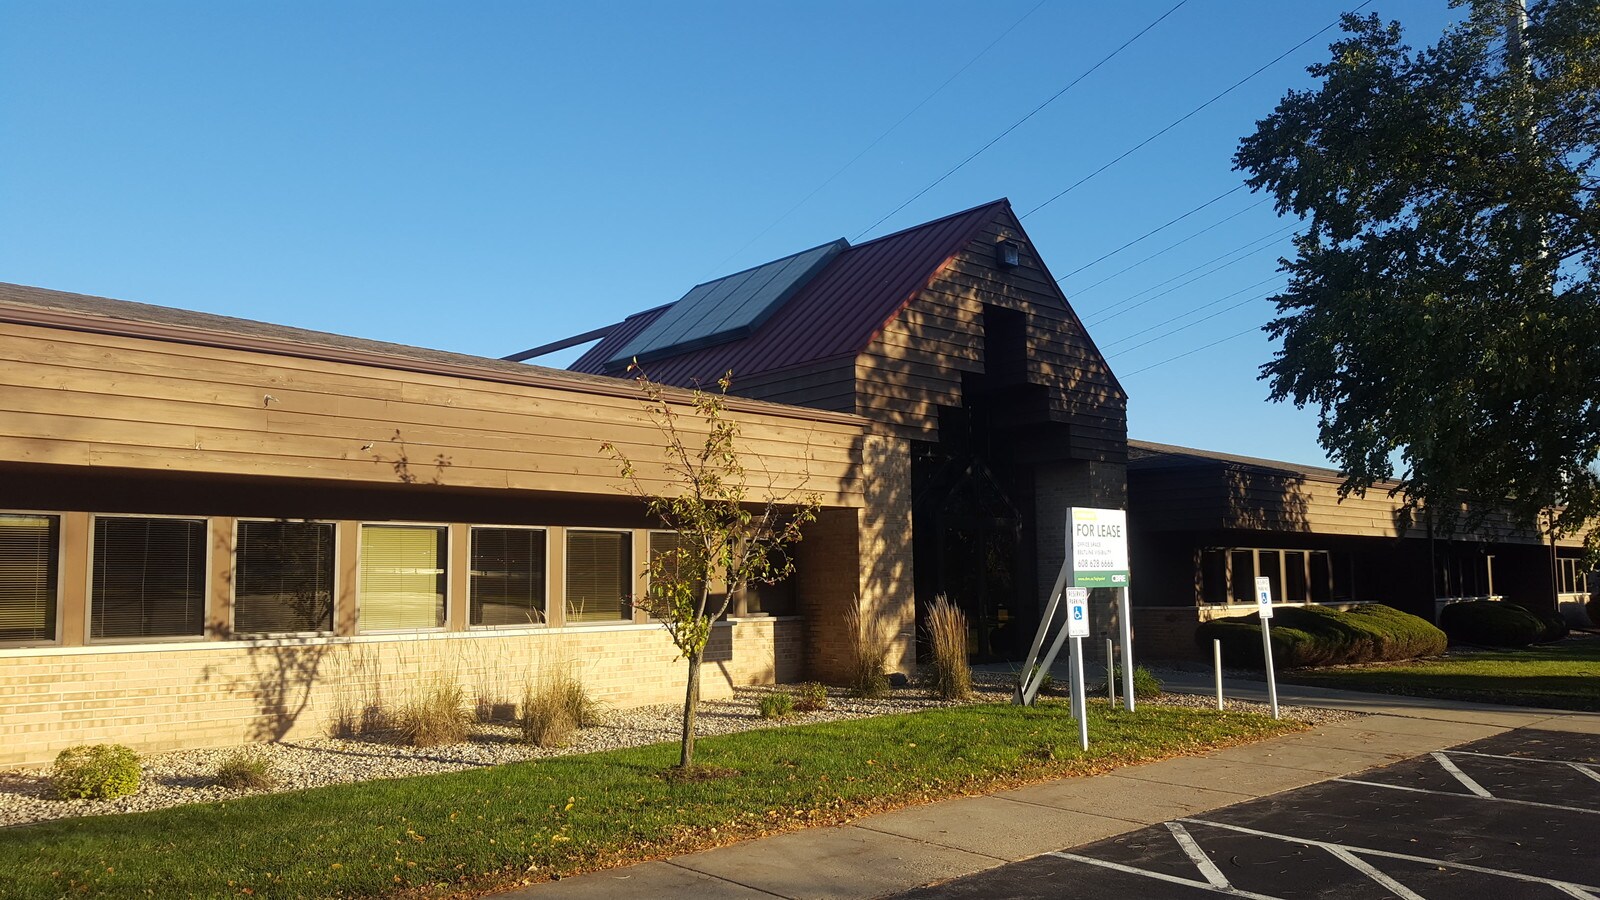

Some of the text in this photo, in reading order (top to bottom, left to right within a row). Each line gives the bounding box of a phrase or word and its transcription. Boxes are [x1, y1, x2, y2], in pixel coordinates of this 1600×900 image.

[1076, 523, 1121, 538] FOR LEASE
[1077, 559, 1114, 568] 608 628 6666
[1111, 574, 1127, 583] CBRE
